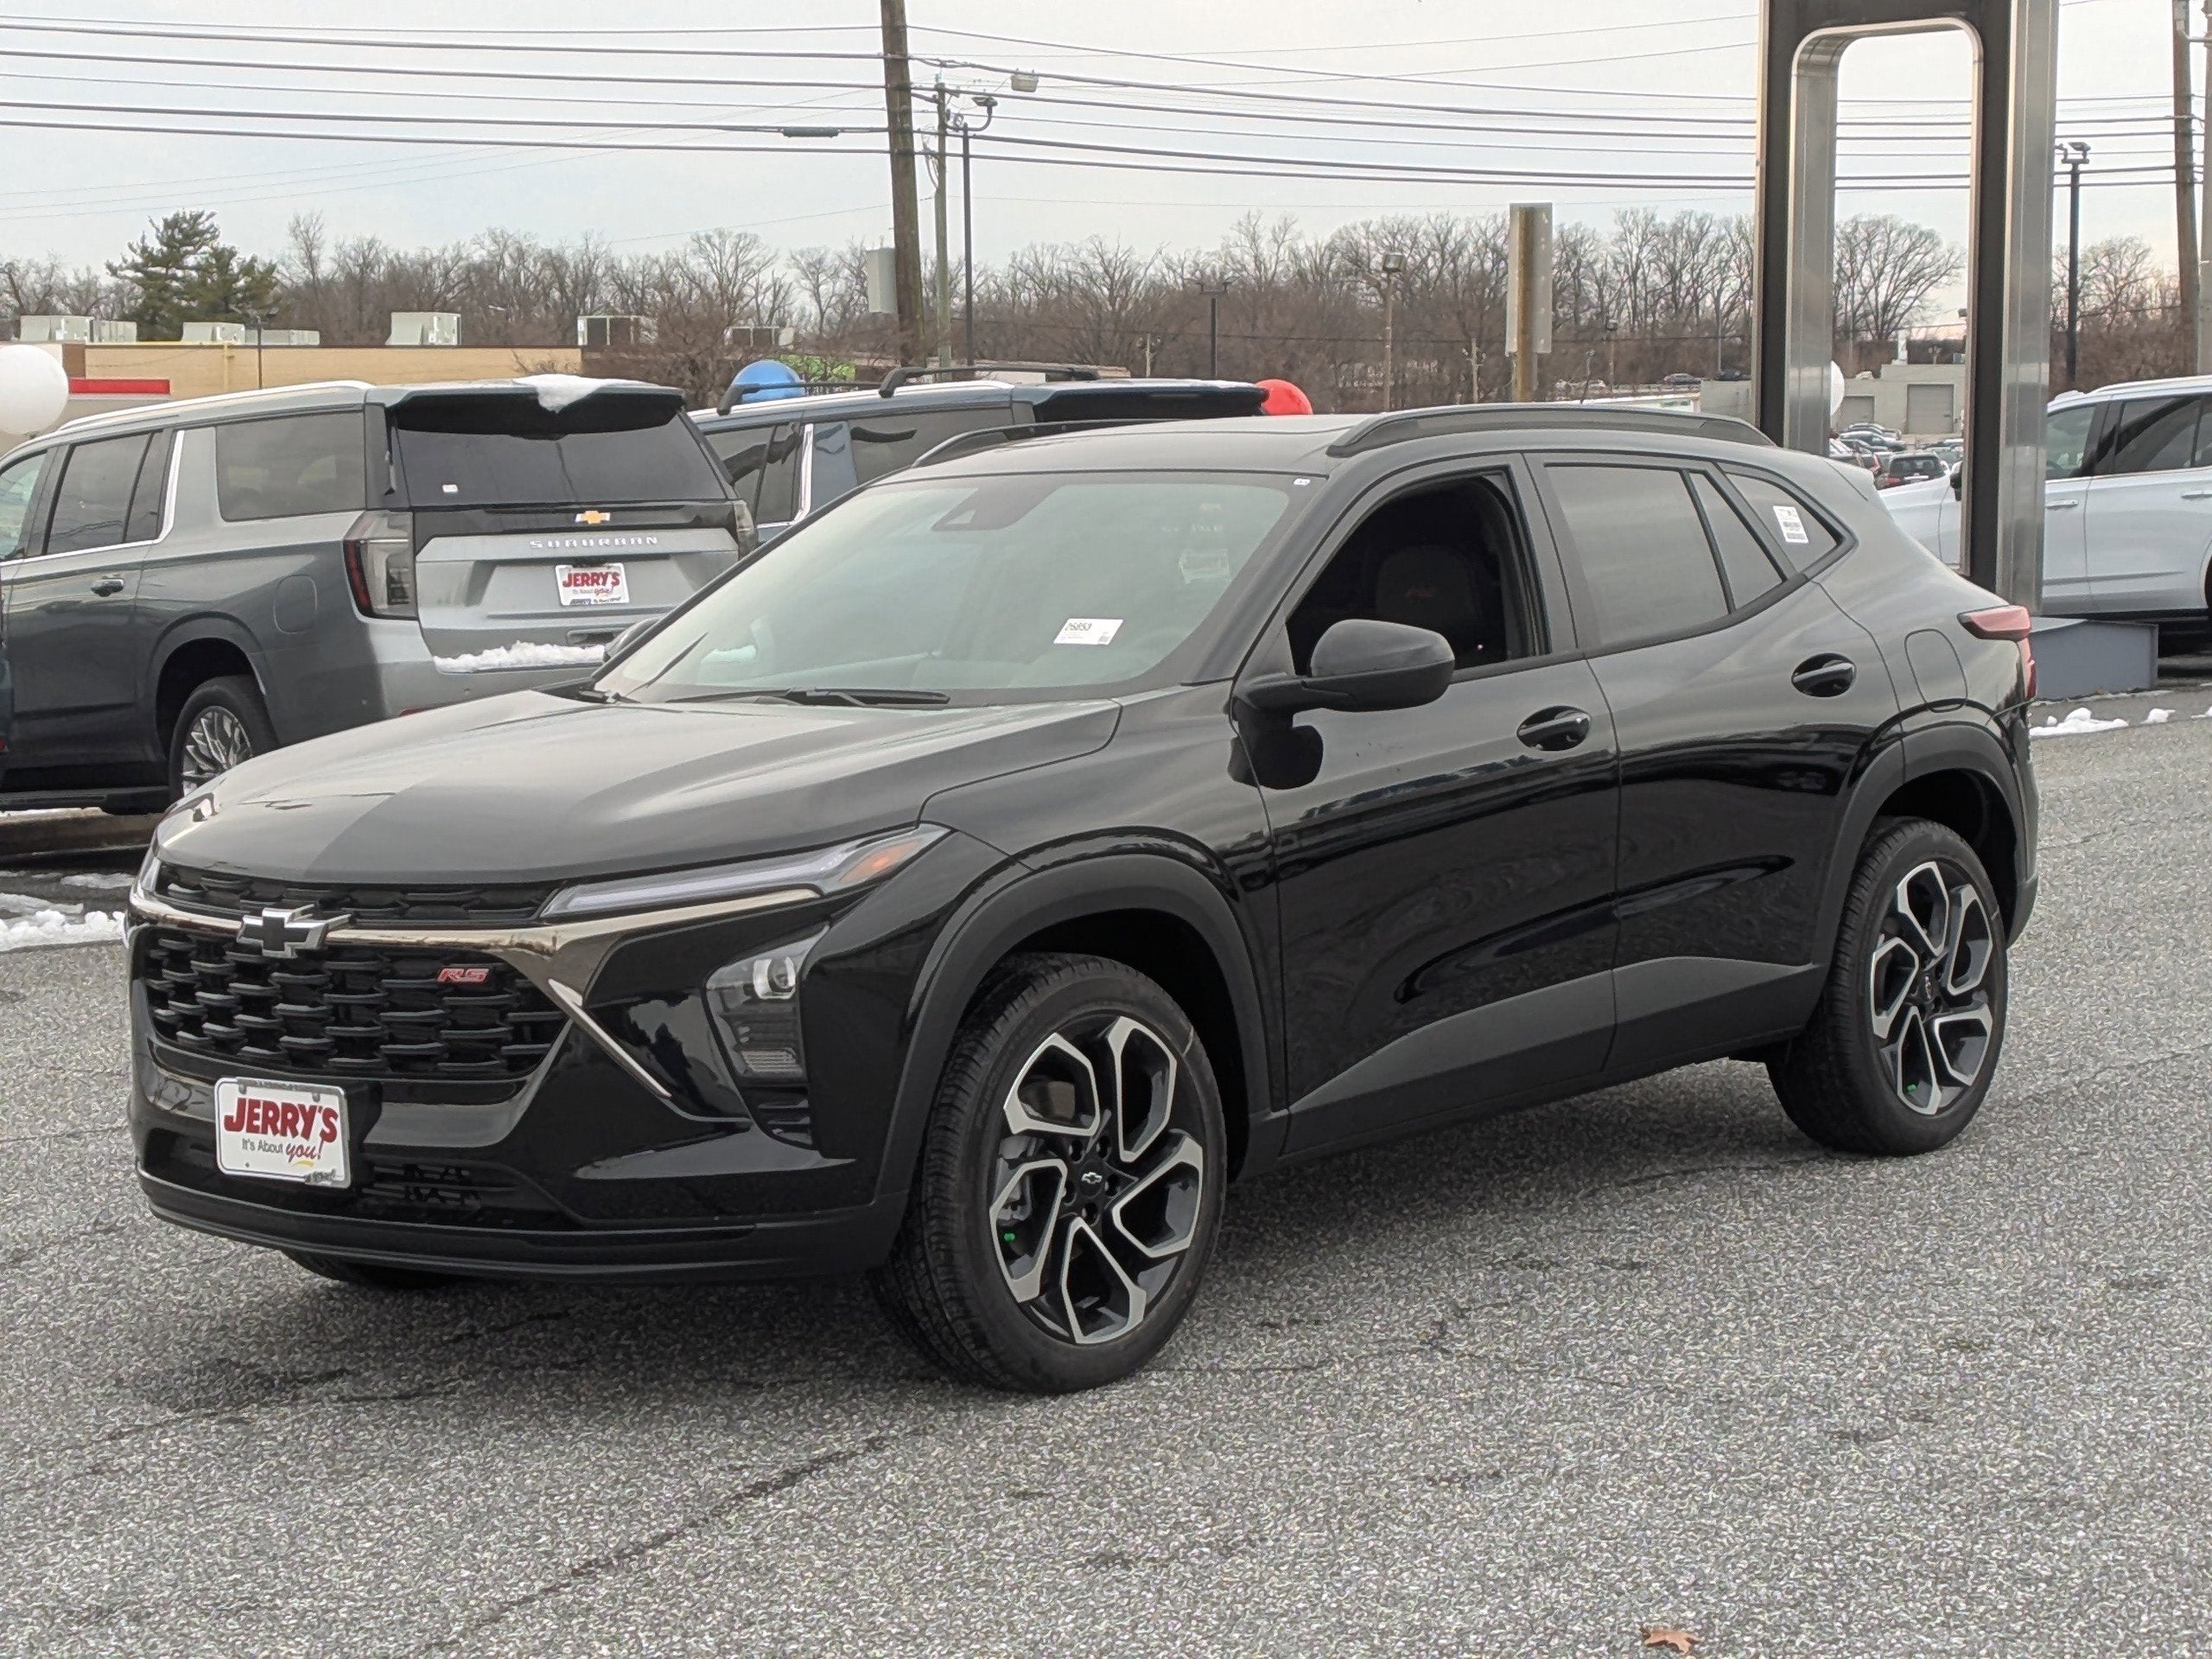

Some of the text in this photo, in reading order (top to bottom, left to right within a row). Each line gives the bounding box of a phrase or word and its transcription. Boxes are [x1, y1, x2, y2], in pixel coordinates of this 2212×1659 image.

[530, 537, 658, 548] SUBURBAN
[563, 571, 620, 588] JERRY'S
[437, 968, 490, 983] RS
[224, 1096, 339, 1143] JERRY'S
[242, 1138, 324, 1163] It's About you!
